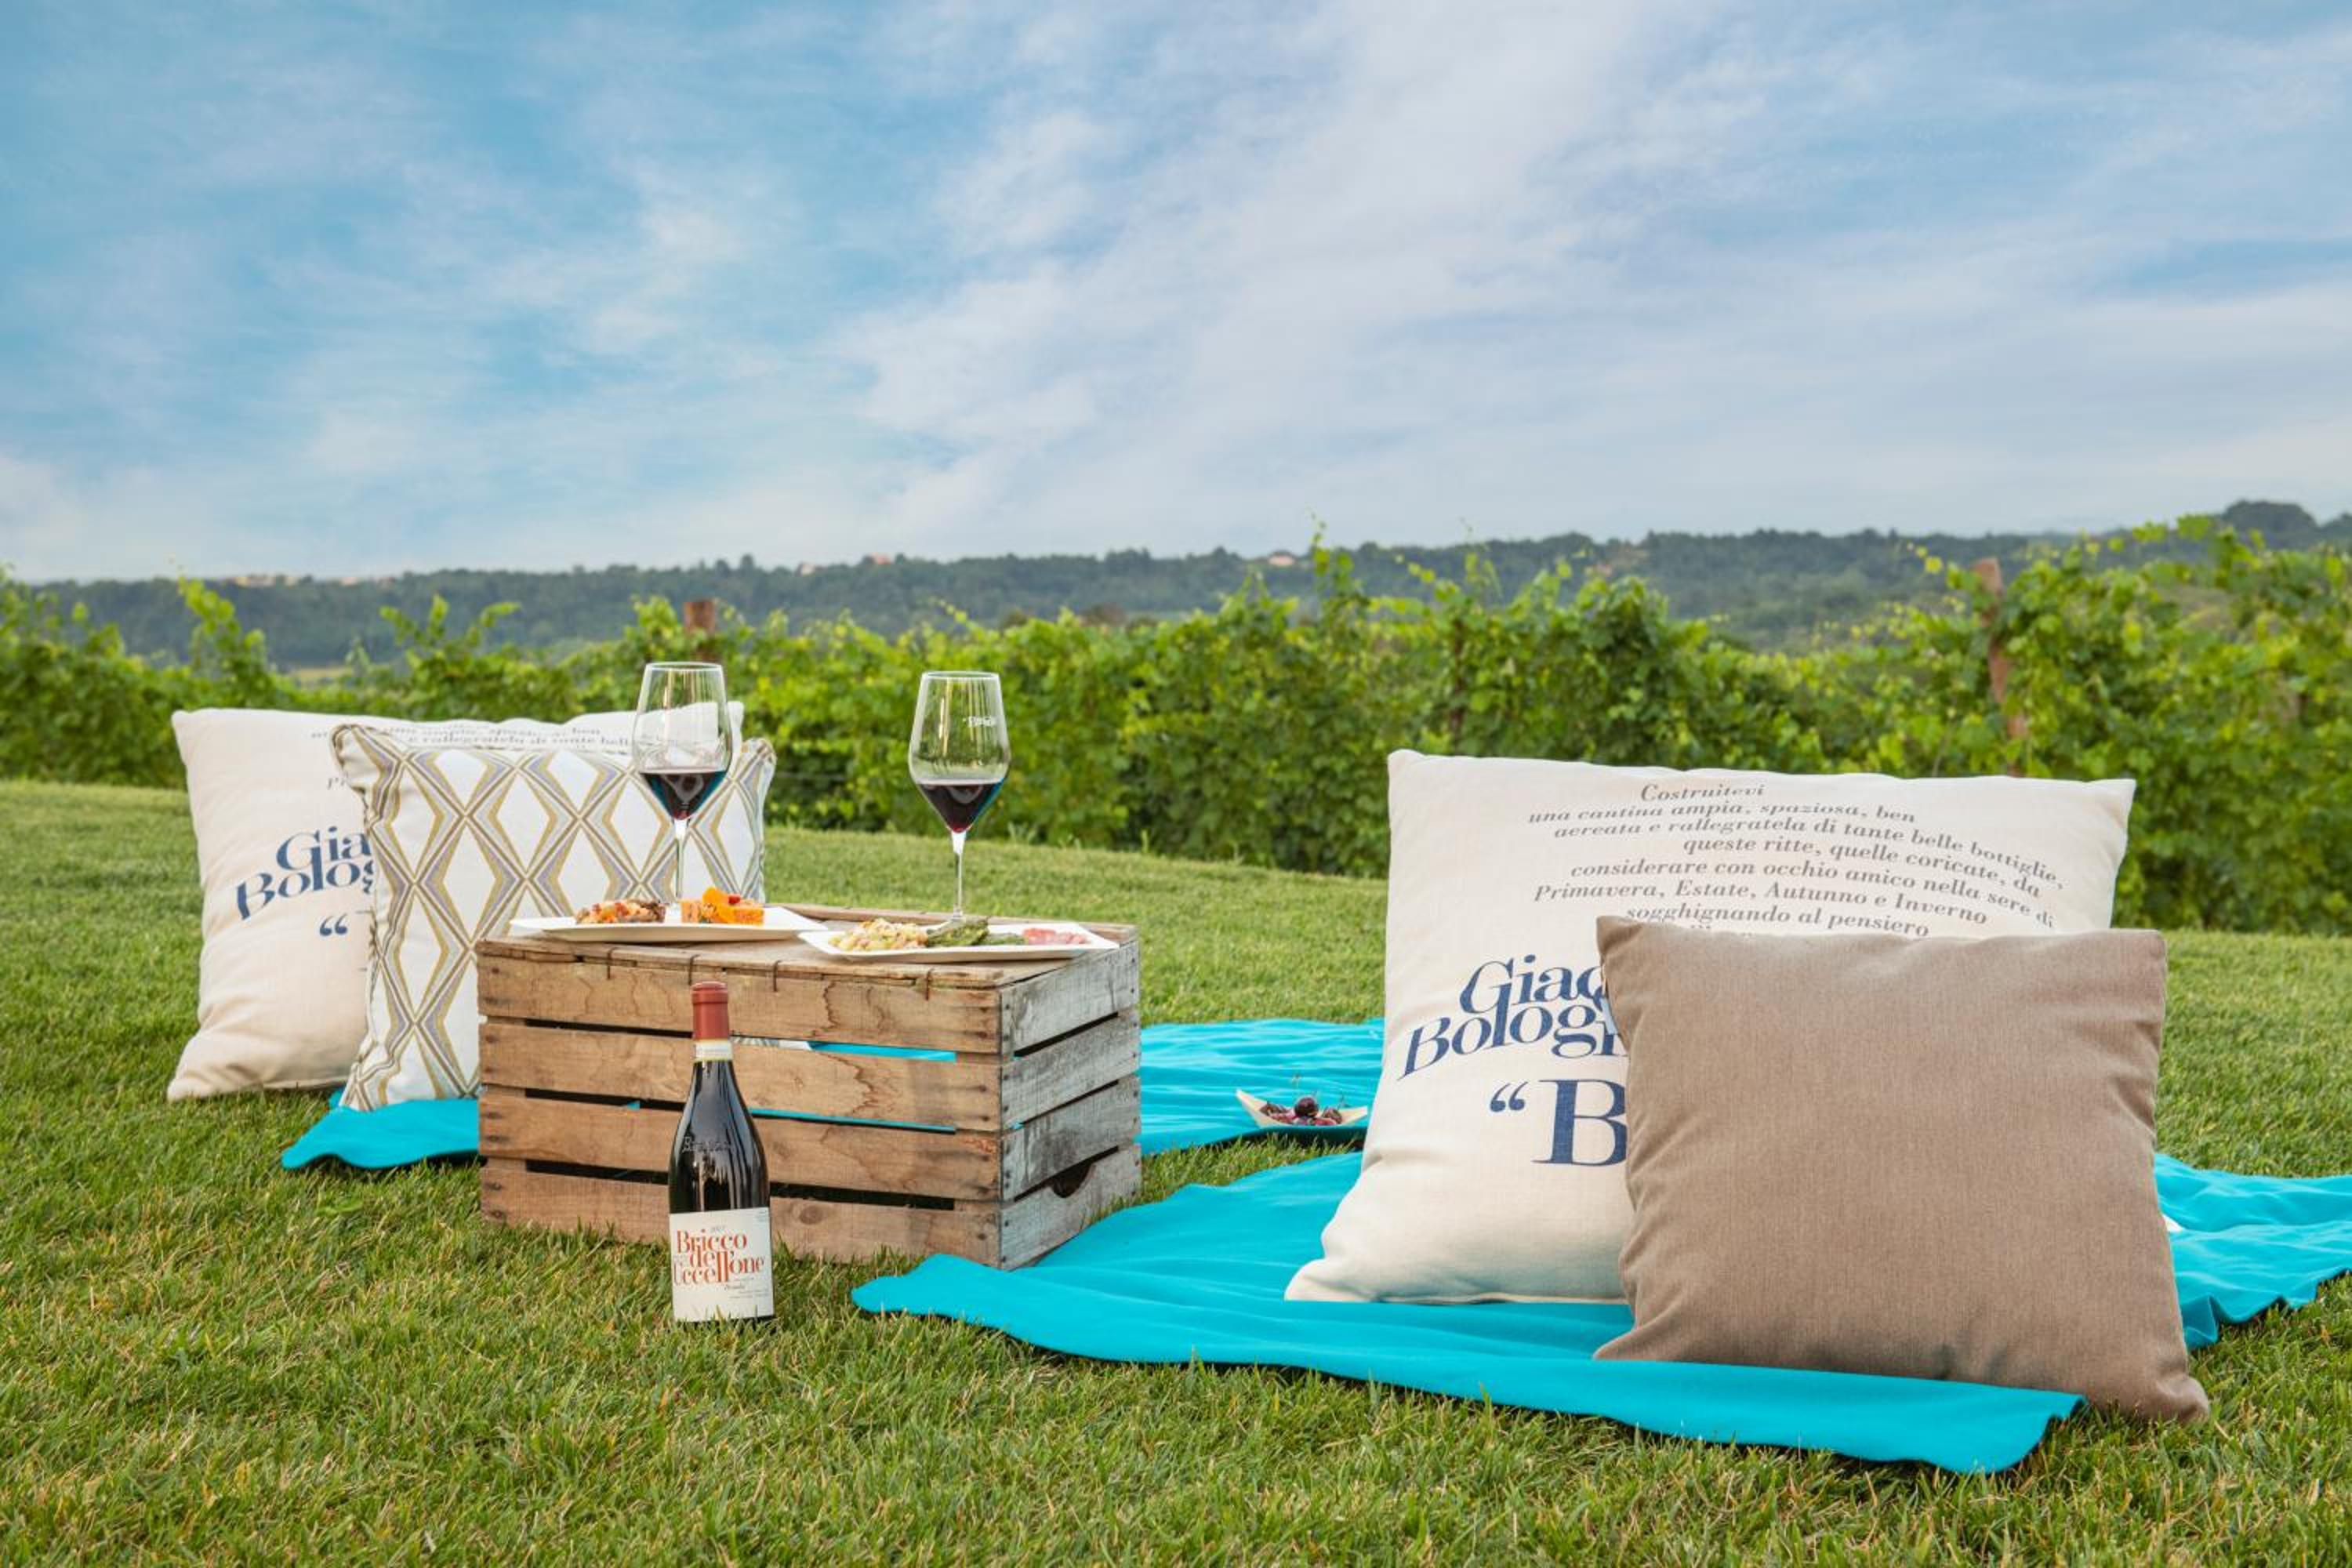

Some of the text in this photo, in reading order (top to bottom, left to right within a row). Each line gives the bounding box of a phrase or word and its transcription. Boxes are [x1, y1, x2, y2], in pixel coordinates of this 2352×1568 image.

[1528, 800, 1915, 824] una cantina ampia, spaziosa, ben
[1640, 783, 1766, 803] Costruitevi
[1555, 817, 2063, 891] aereata e rallegratela di tante belle bottiglie,
[1683, 836, 2041, 899] queste ritte, quelle coricate, da
[1534, 878, 1988, 925] Primavera, Estate, Autunno e Inverno
[1570, 858, 2056, 929] considerare con occhio amico nella sere di
[1625, 902, 1930, 938] sogghignando al pensiero
[677, 1229, 748, 1254] Bricco
